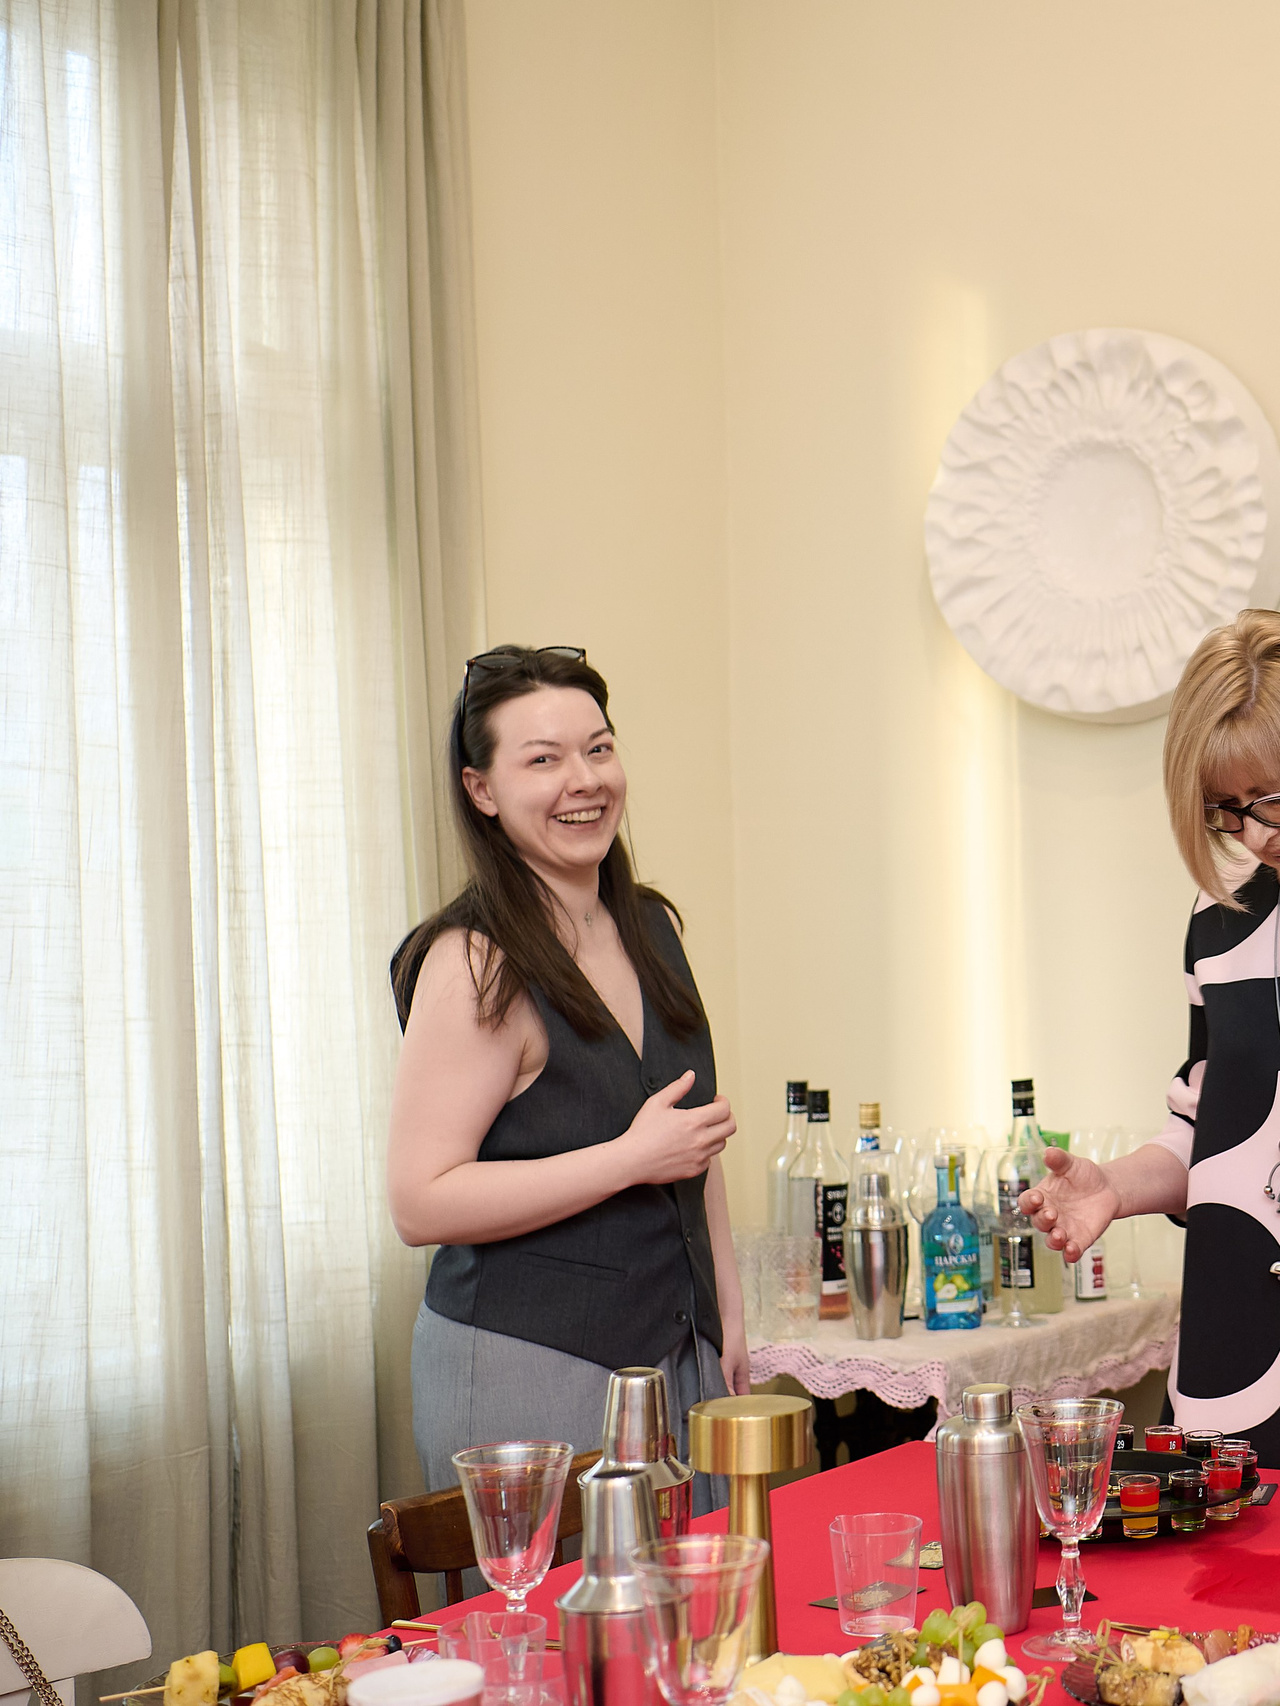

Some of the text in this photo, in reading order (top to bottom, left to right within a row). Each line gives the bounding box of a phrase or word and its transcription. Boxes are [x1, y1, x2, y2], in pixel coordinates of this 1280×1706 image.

[1116, 1439, 1125, 1450] 29
[1169, 1440, 1177, 1450] 16
[1198, 1487, 1203, 1498] 2
